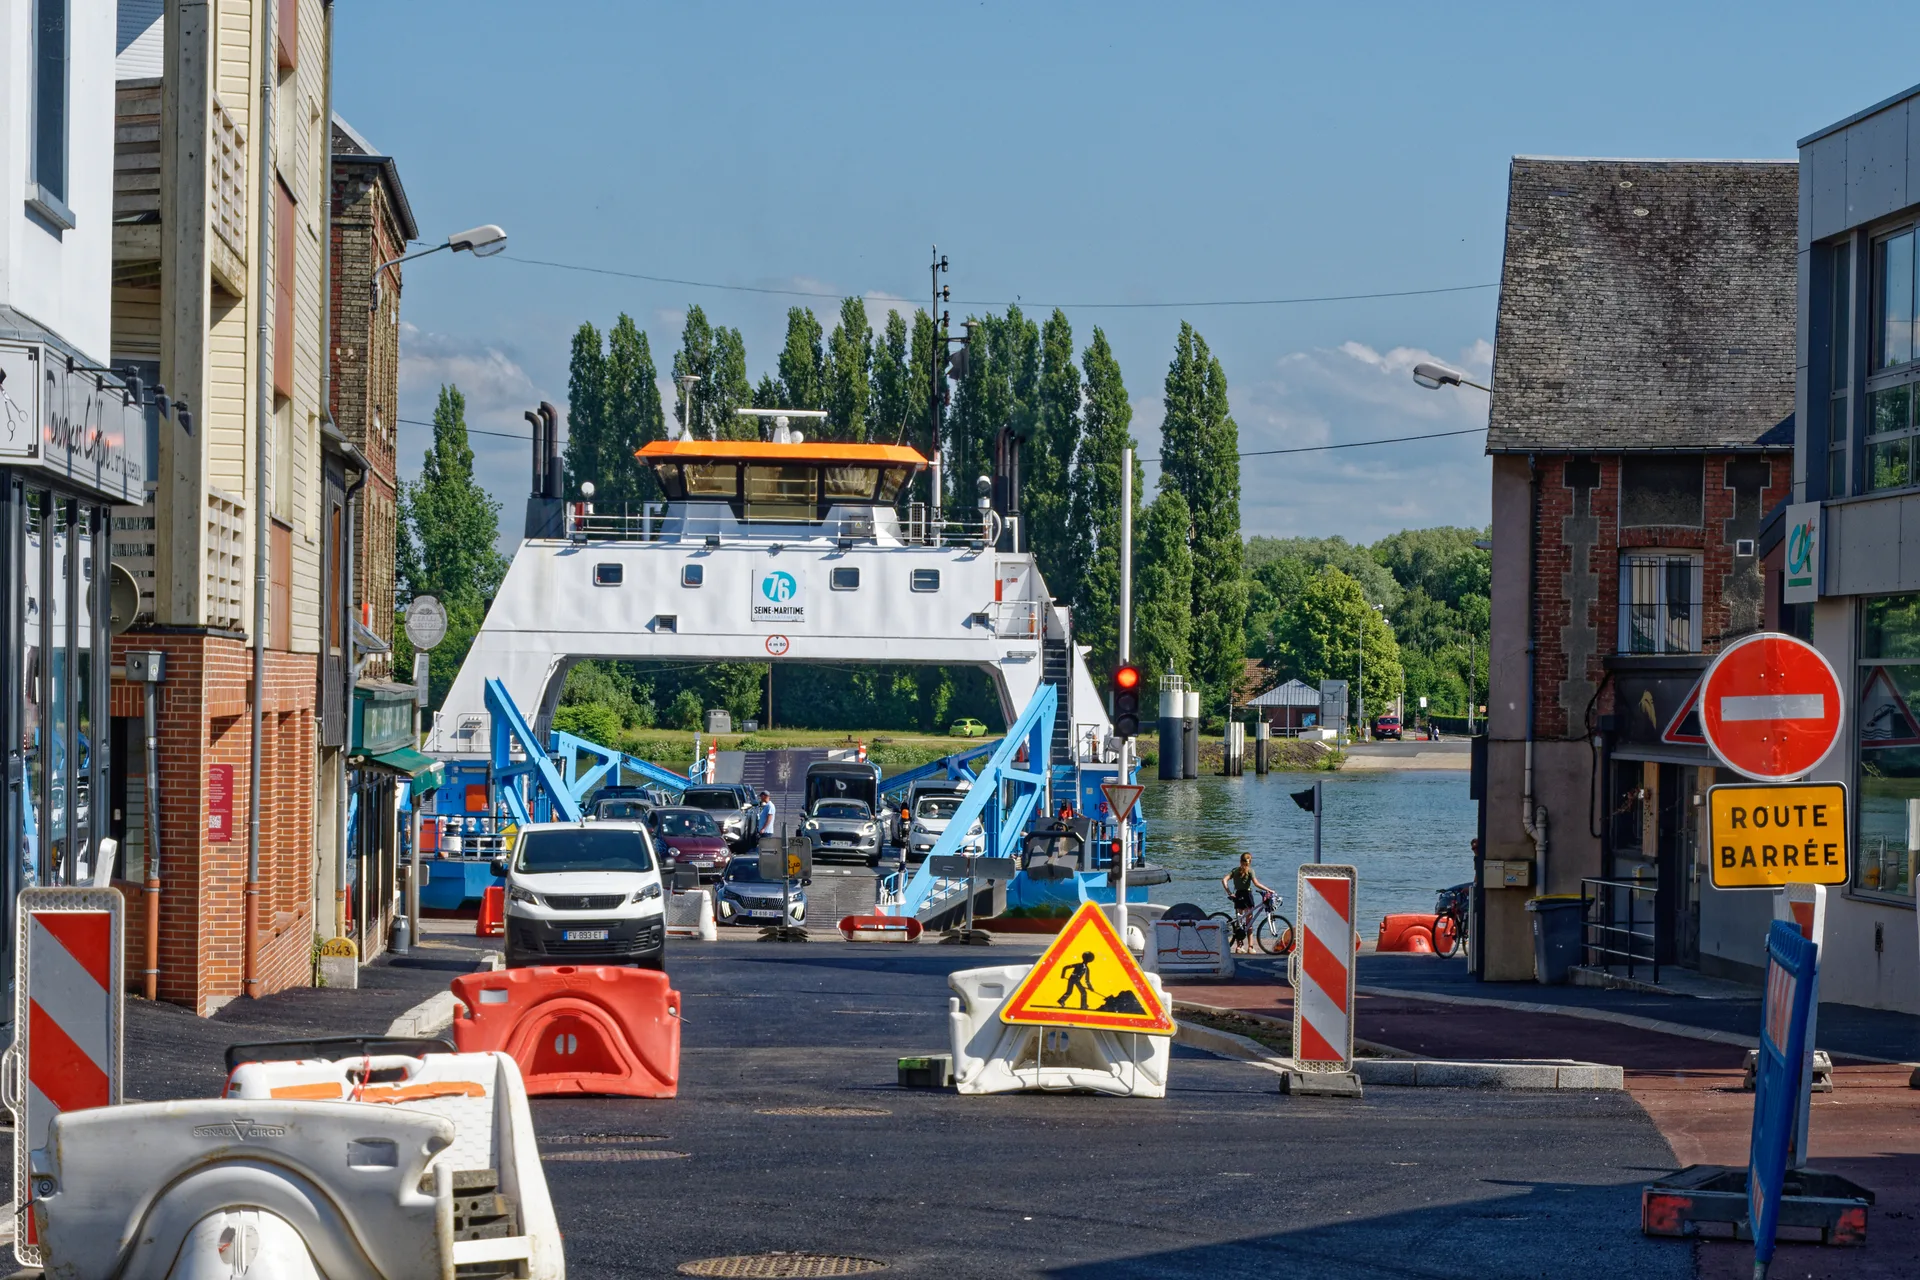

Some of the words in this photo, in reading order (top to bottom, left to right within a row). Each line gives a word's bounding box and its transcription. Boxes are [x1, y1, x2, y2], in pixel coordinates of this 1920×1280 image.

[765, 574, 791, 602] 76
[754, 606, 804, 615] SEINE-MARITIME
[1731, 804, 1828, 829] ROUTE
[1721, 838, 1838, 868] BARRÉE
[193, 1126, 236, 1138] SIGNAUX
[249, 1127, 285, 1138] GIROD
